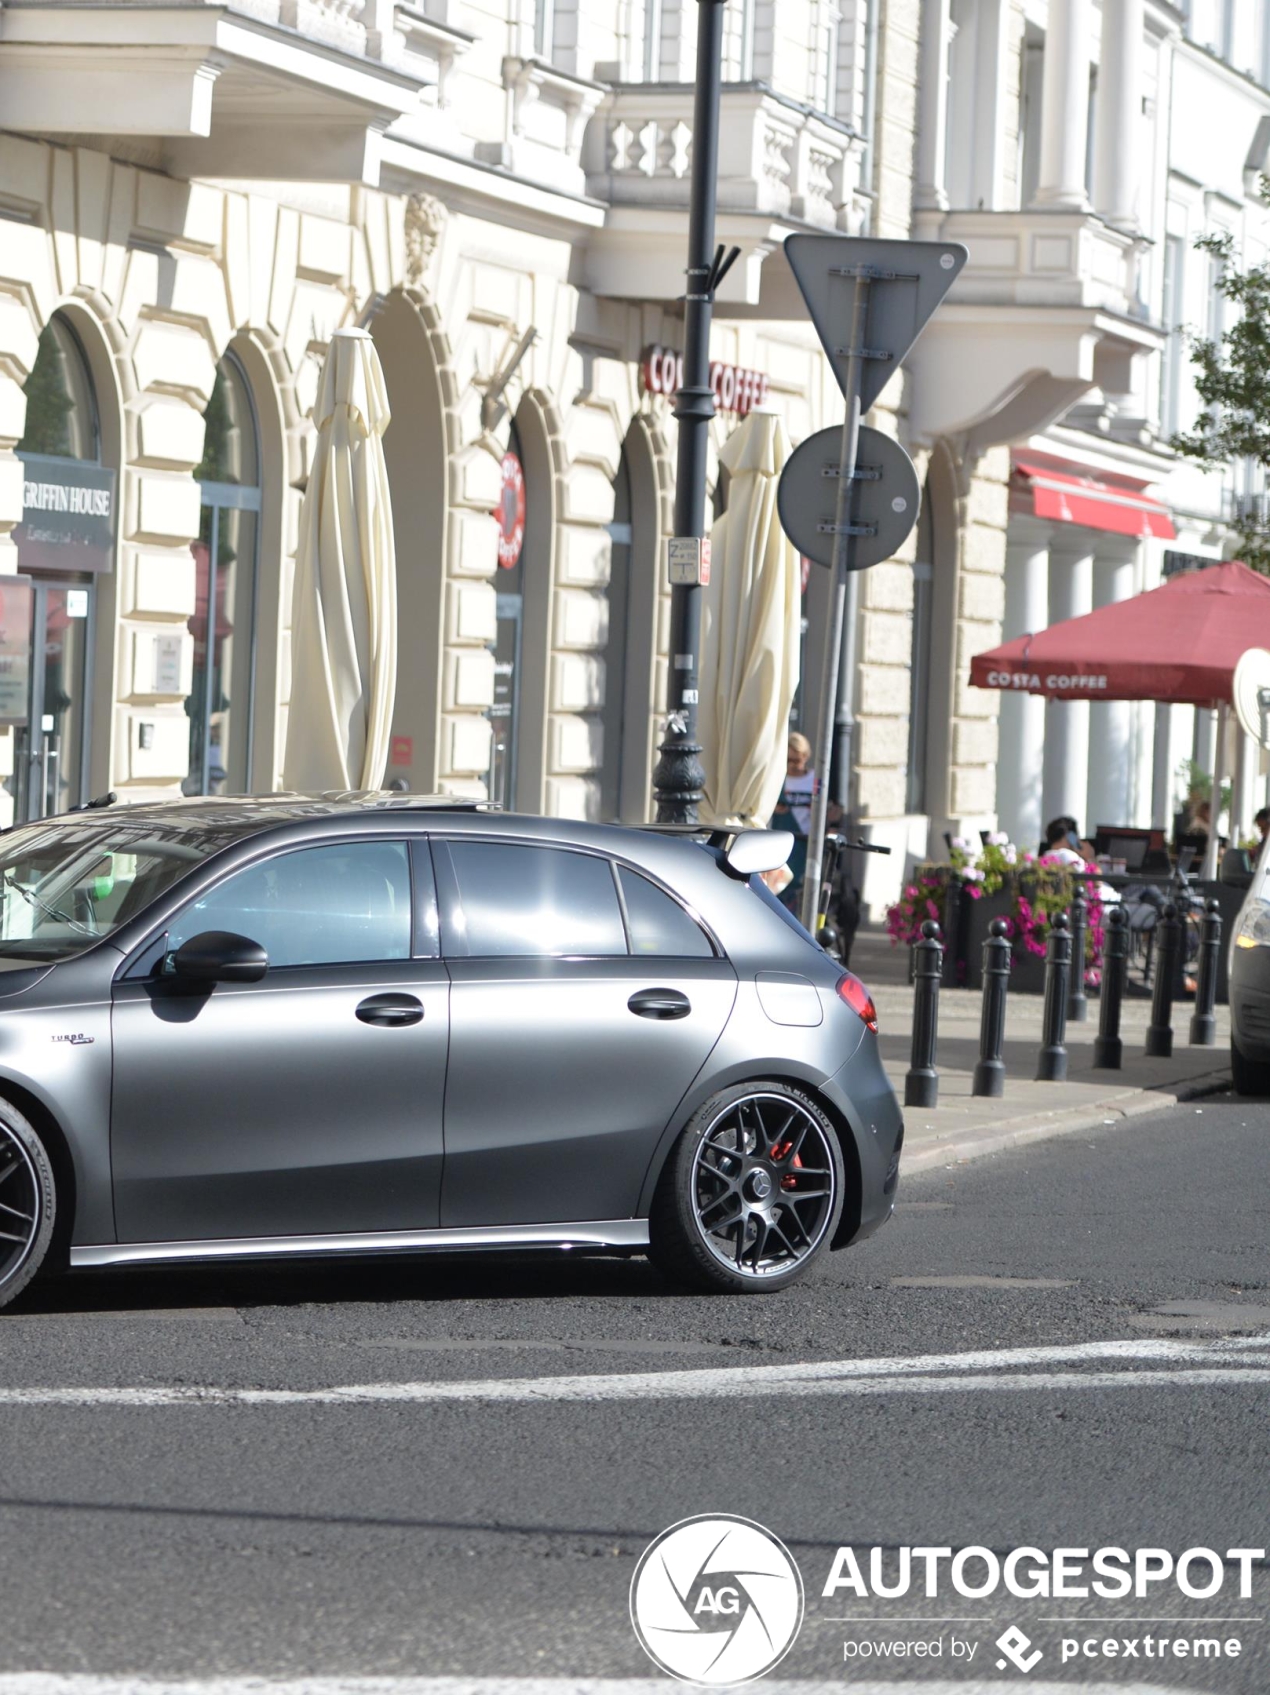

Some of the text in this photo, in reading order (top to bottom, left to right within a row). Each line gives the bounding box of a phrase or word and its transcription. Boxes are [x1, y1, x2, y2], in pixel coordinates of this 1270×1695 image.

[23, 481, 110, 517] GRIFFIN HOUSE
[986, 671, 1108, 690] COSTA COFFEE
